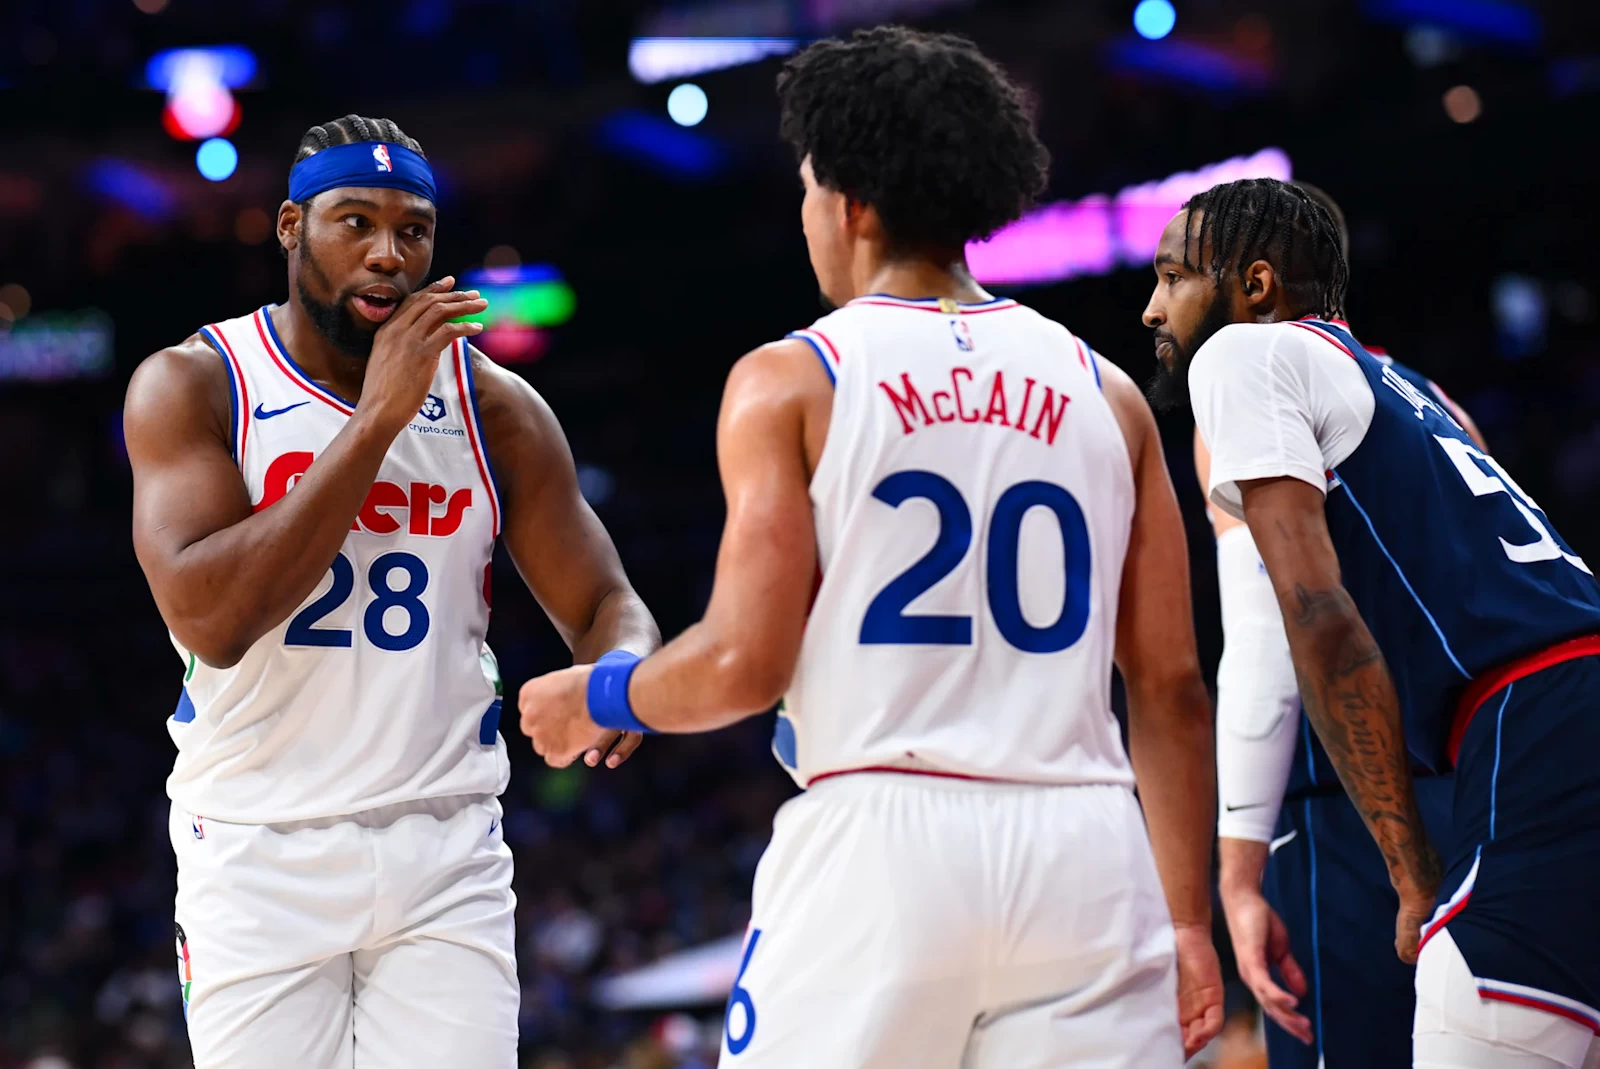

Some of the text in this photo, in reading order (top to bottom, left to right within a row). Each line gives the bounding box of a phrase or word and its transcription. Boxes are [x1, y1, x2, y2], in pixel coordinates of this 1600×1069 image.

[409, 423, 464, 436] crypto.com
[878, 367, 1071, 446] McCAIN
[284, 551, 431, 652] 28
[858, 469, 1092, 654] 20
